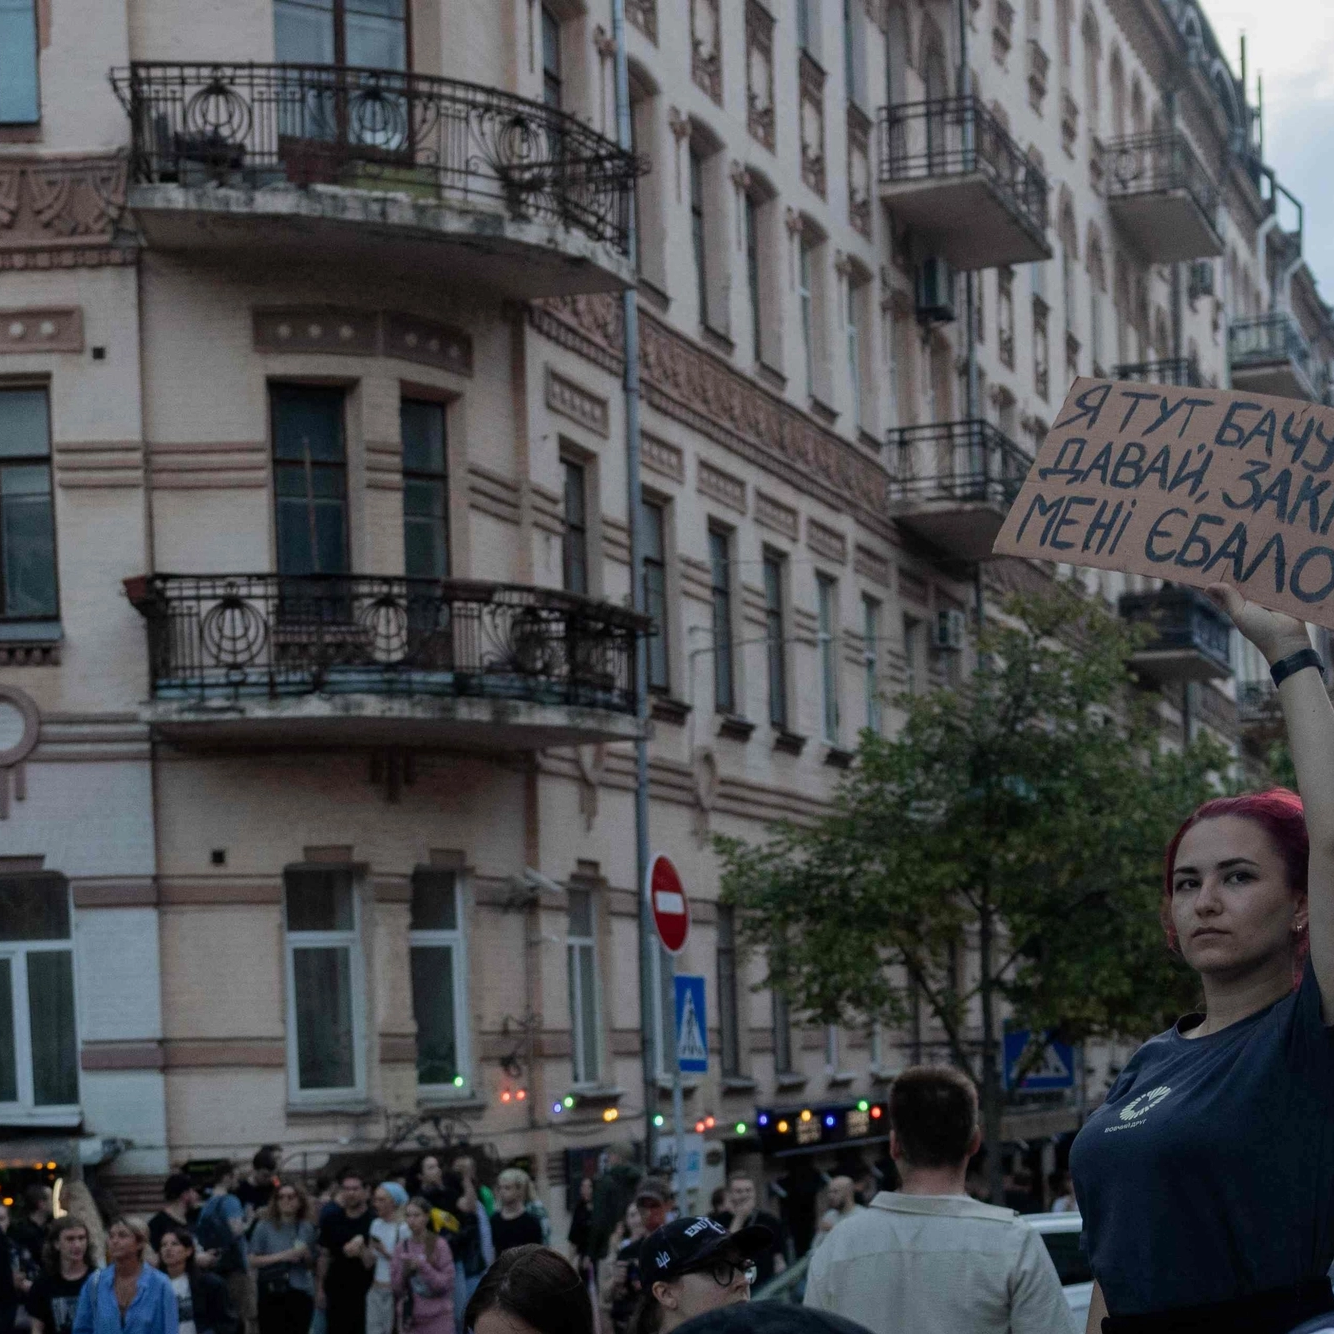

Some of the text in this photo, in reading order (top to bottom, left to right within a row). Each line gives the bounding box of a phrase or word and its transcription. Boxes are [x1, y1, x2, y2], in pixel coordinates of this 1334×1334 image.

[1056, 384, 1113, 432] Я
[1120, 391, 1215, 438] ТУТ
[1016, 494, 1136, 556] МЕНІ
